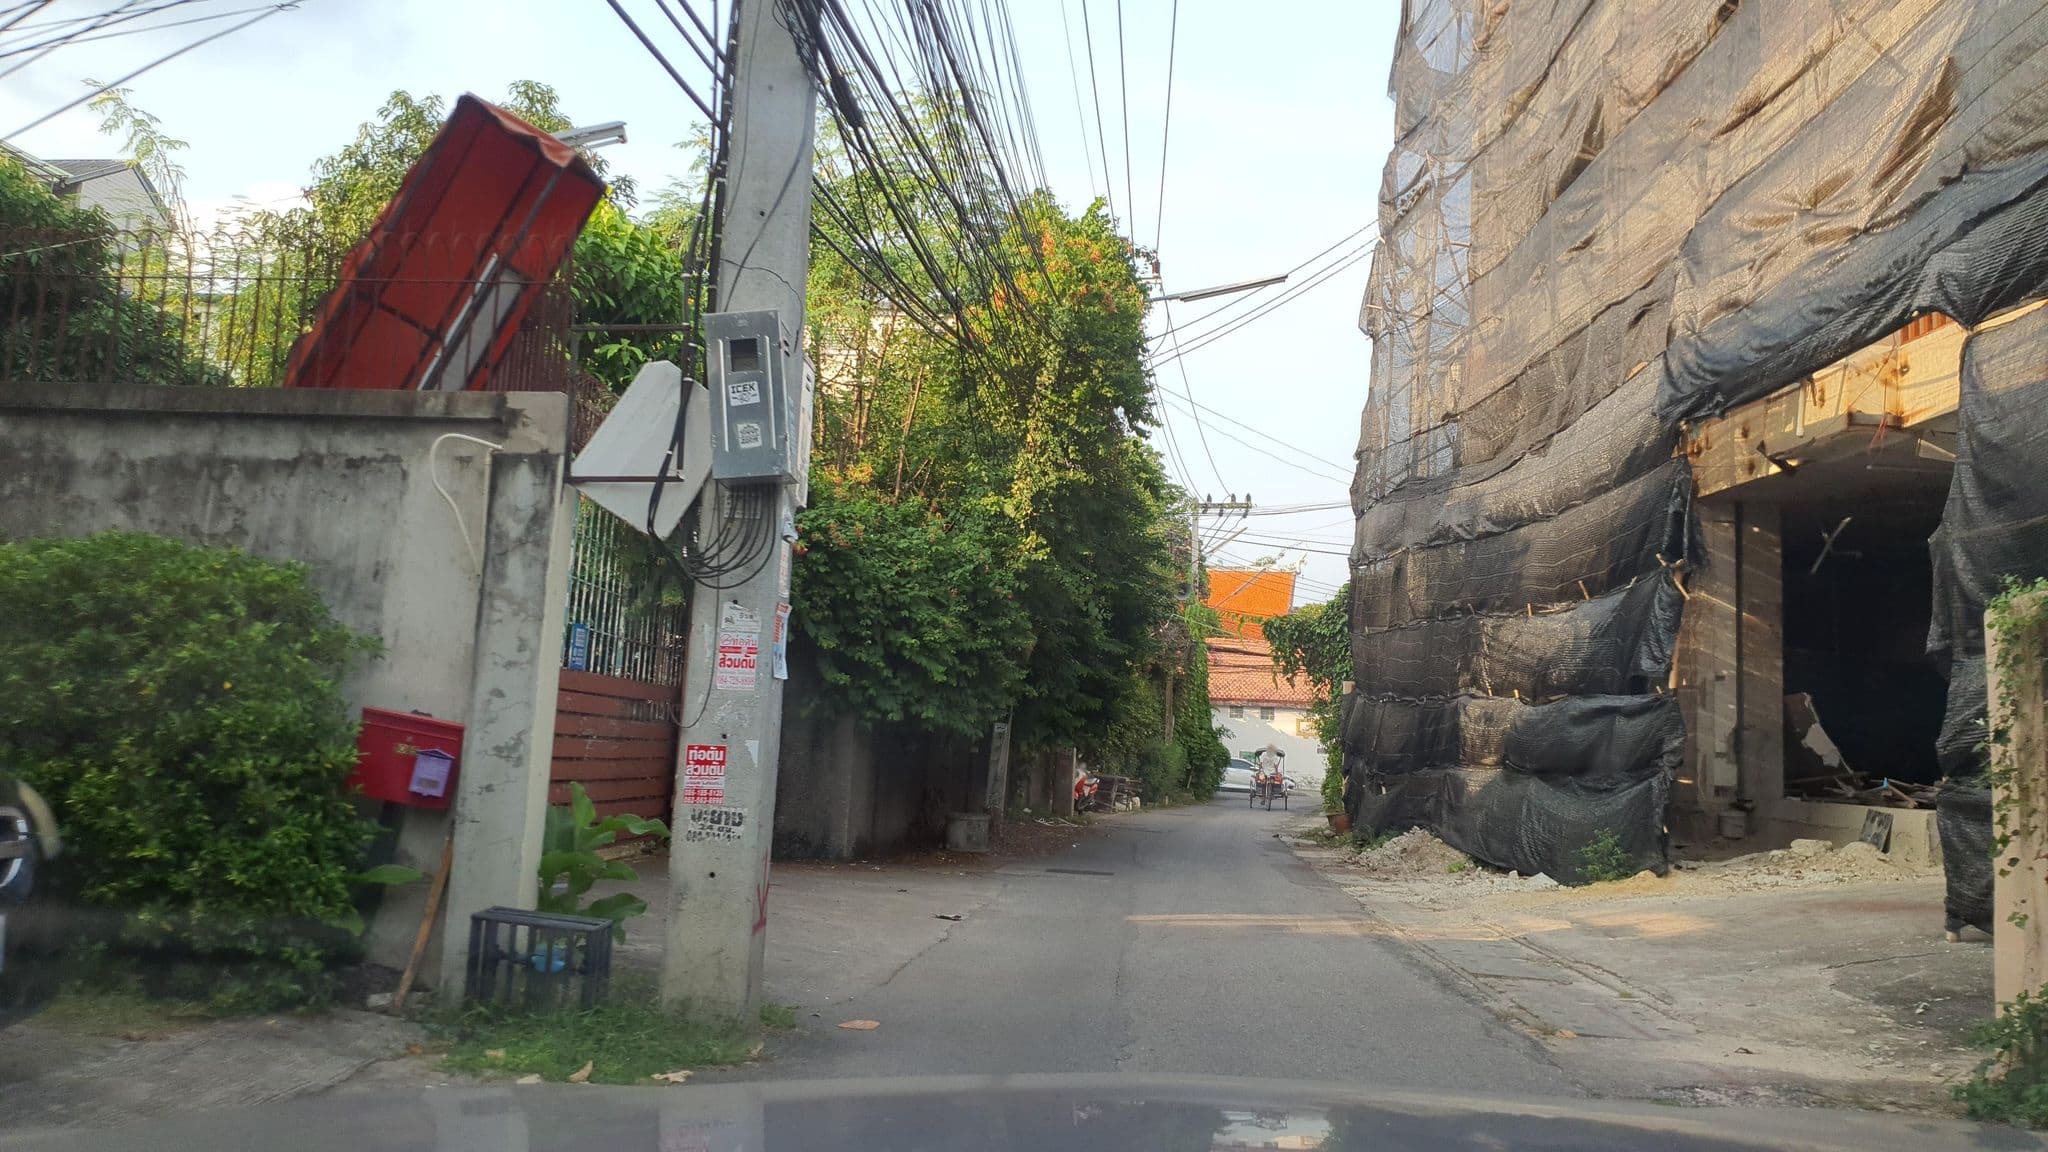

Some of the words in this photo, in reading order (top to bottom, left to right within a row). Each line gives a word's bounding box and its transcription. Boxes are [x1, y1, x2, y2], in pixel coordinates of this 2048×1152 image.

[719, 654, 755, 669] ส้วมตัน
[688, 746, 724, 761] ท่อตัน
[686, 762, 725, 775] ส้วมตัน
